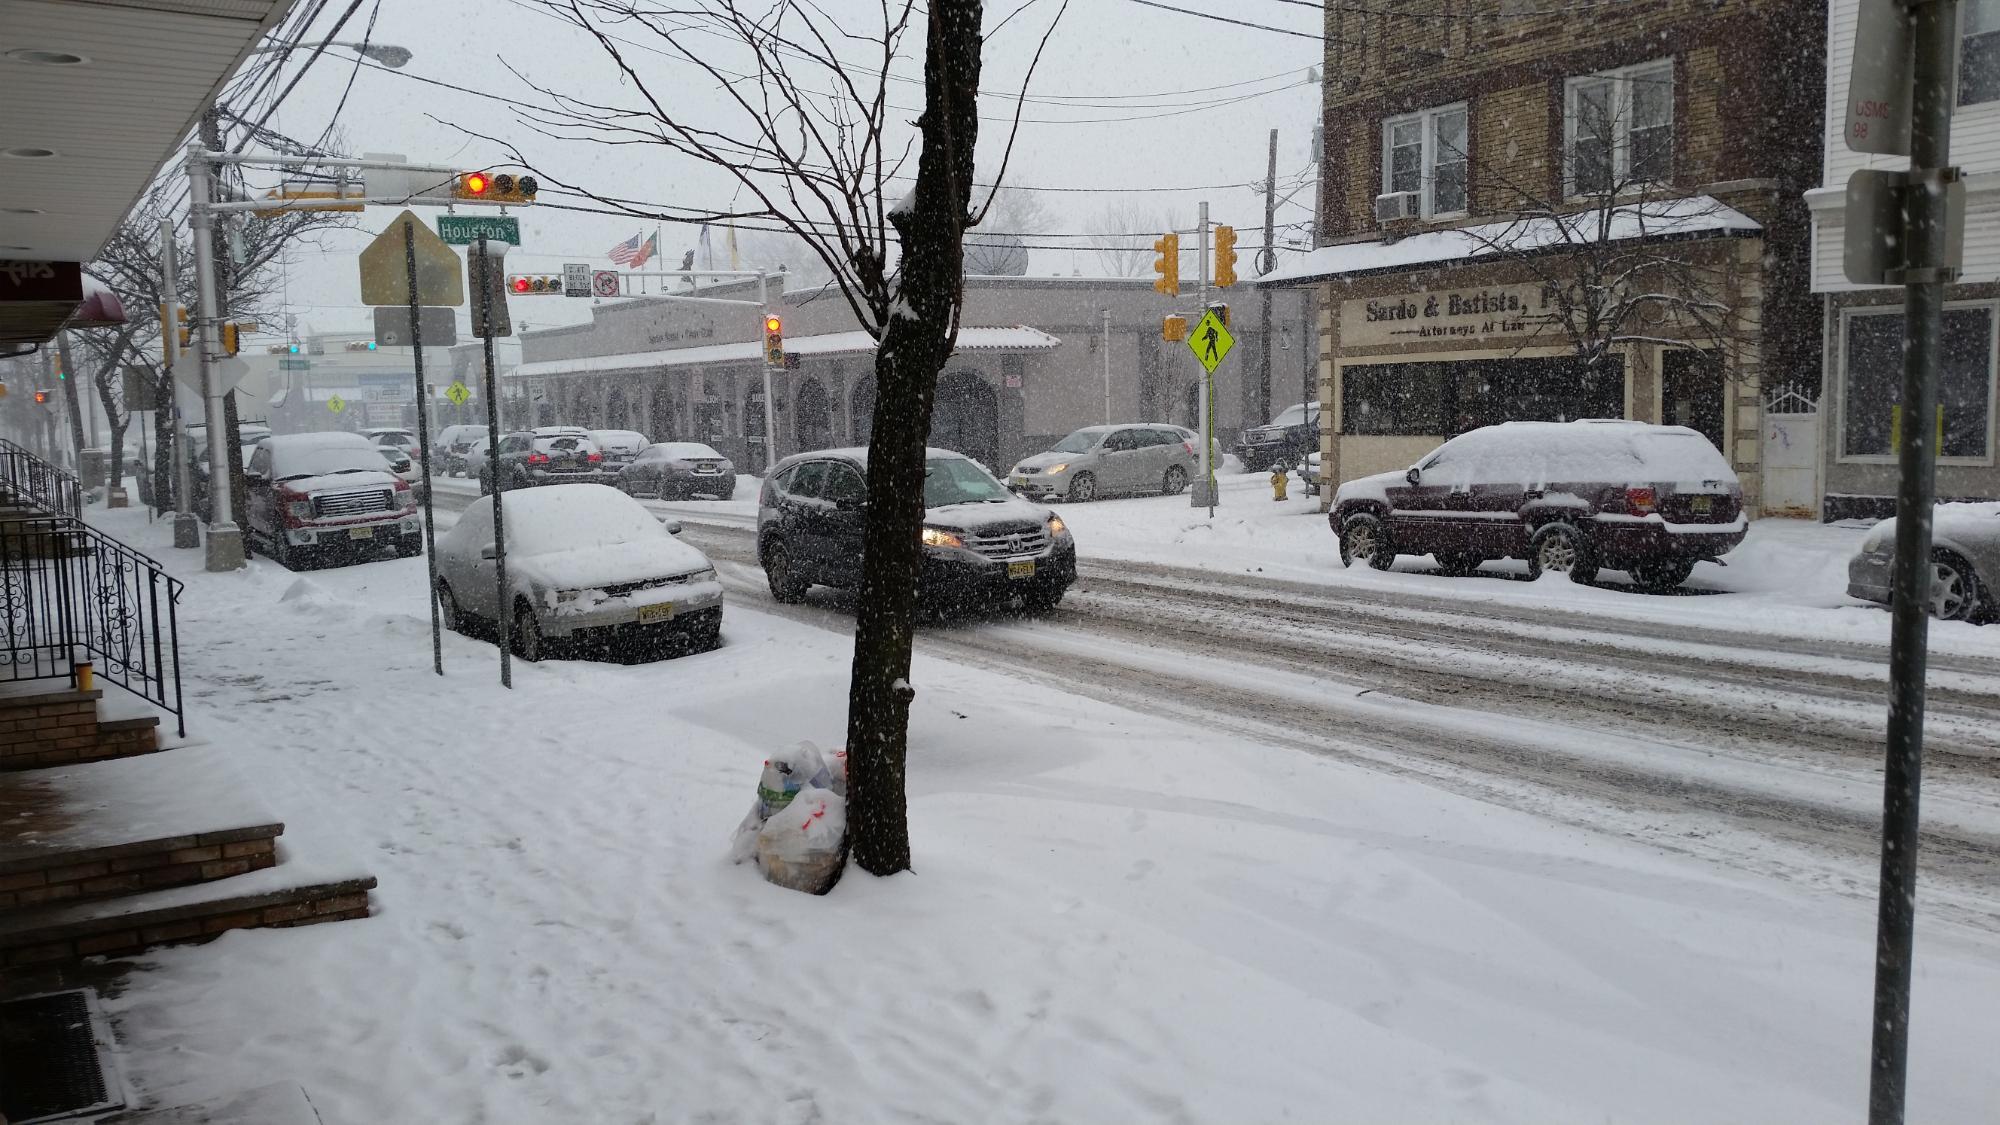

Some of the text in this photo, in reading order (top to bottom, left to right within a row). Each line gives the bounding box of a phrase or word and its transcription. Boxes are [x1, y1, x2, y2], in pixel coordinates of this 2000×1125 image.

[441, 223, 505, 239] Houston
[1367, 299, 1417, 322] Sardo
[1424, 295, 1440, 317] &
[1448, 290, 1528, 316] Batista,
[1420, 324, 1475, 337] Attorneys
